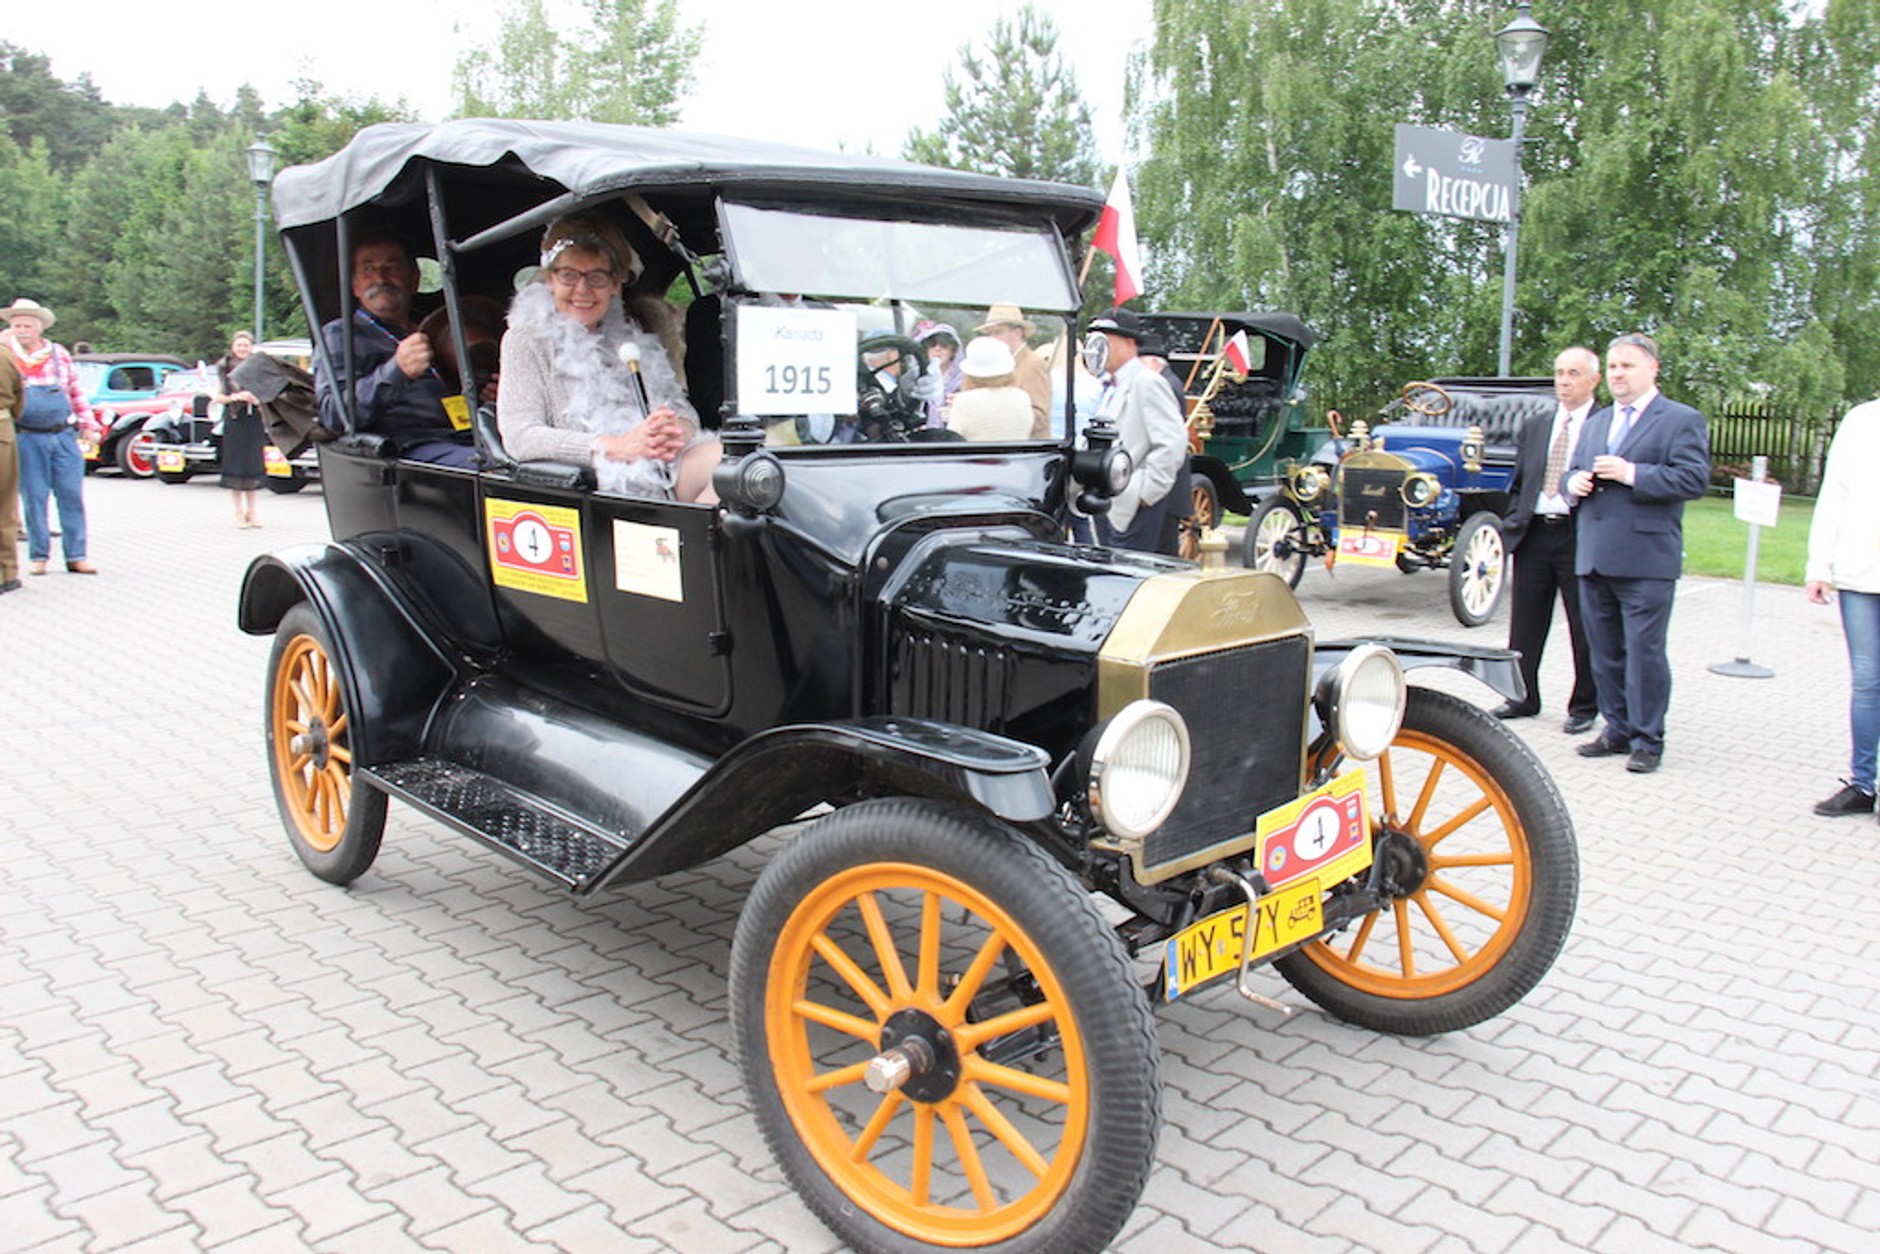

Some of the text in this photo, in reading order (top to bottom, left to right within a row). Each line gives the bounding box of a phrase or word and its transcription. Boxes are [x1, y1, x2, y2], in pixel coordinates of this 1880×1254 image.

[775, 325, 823, 342] Kanada
[766, 364, 831, 395] 1915
[529, 528, 538, 557] 4
[1313, 815, 1325, 849] 4
[1181, 925, 1217, 984] WY
